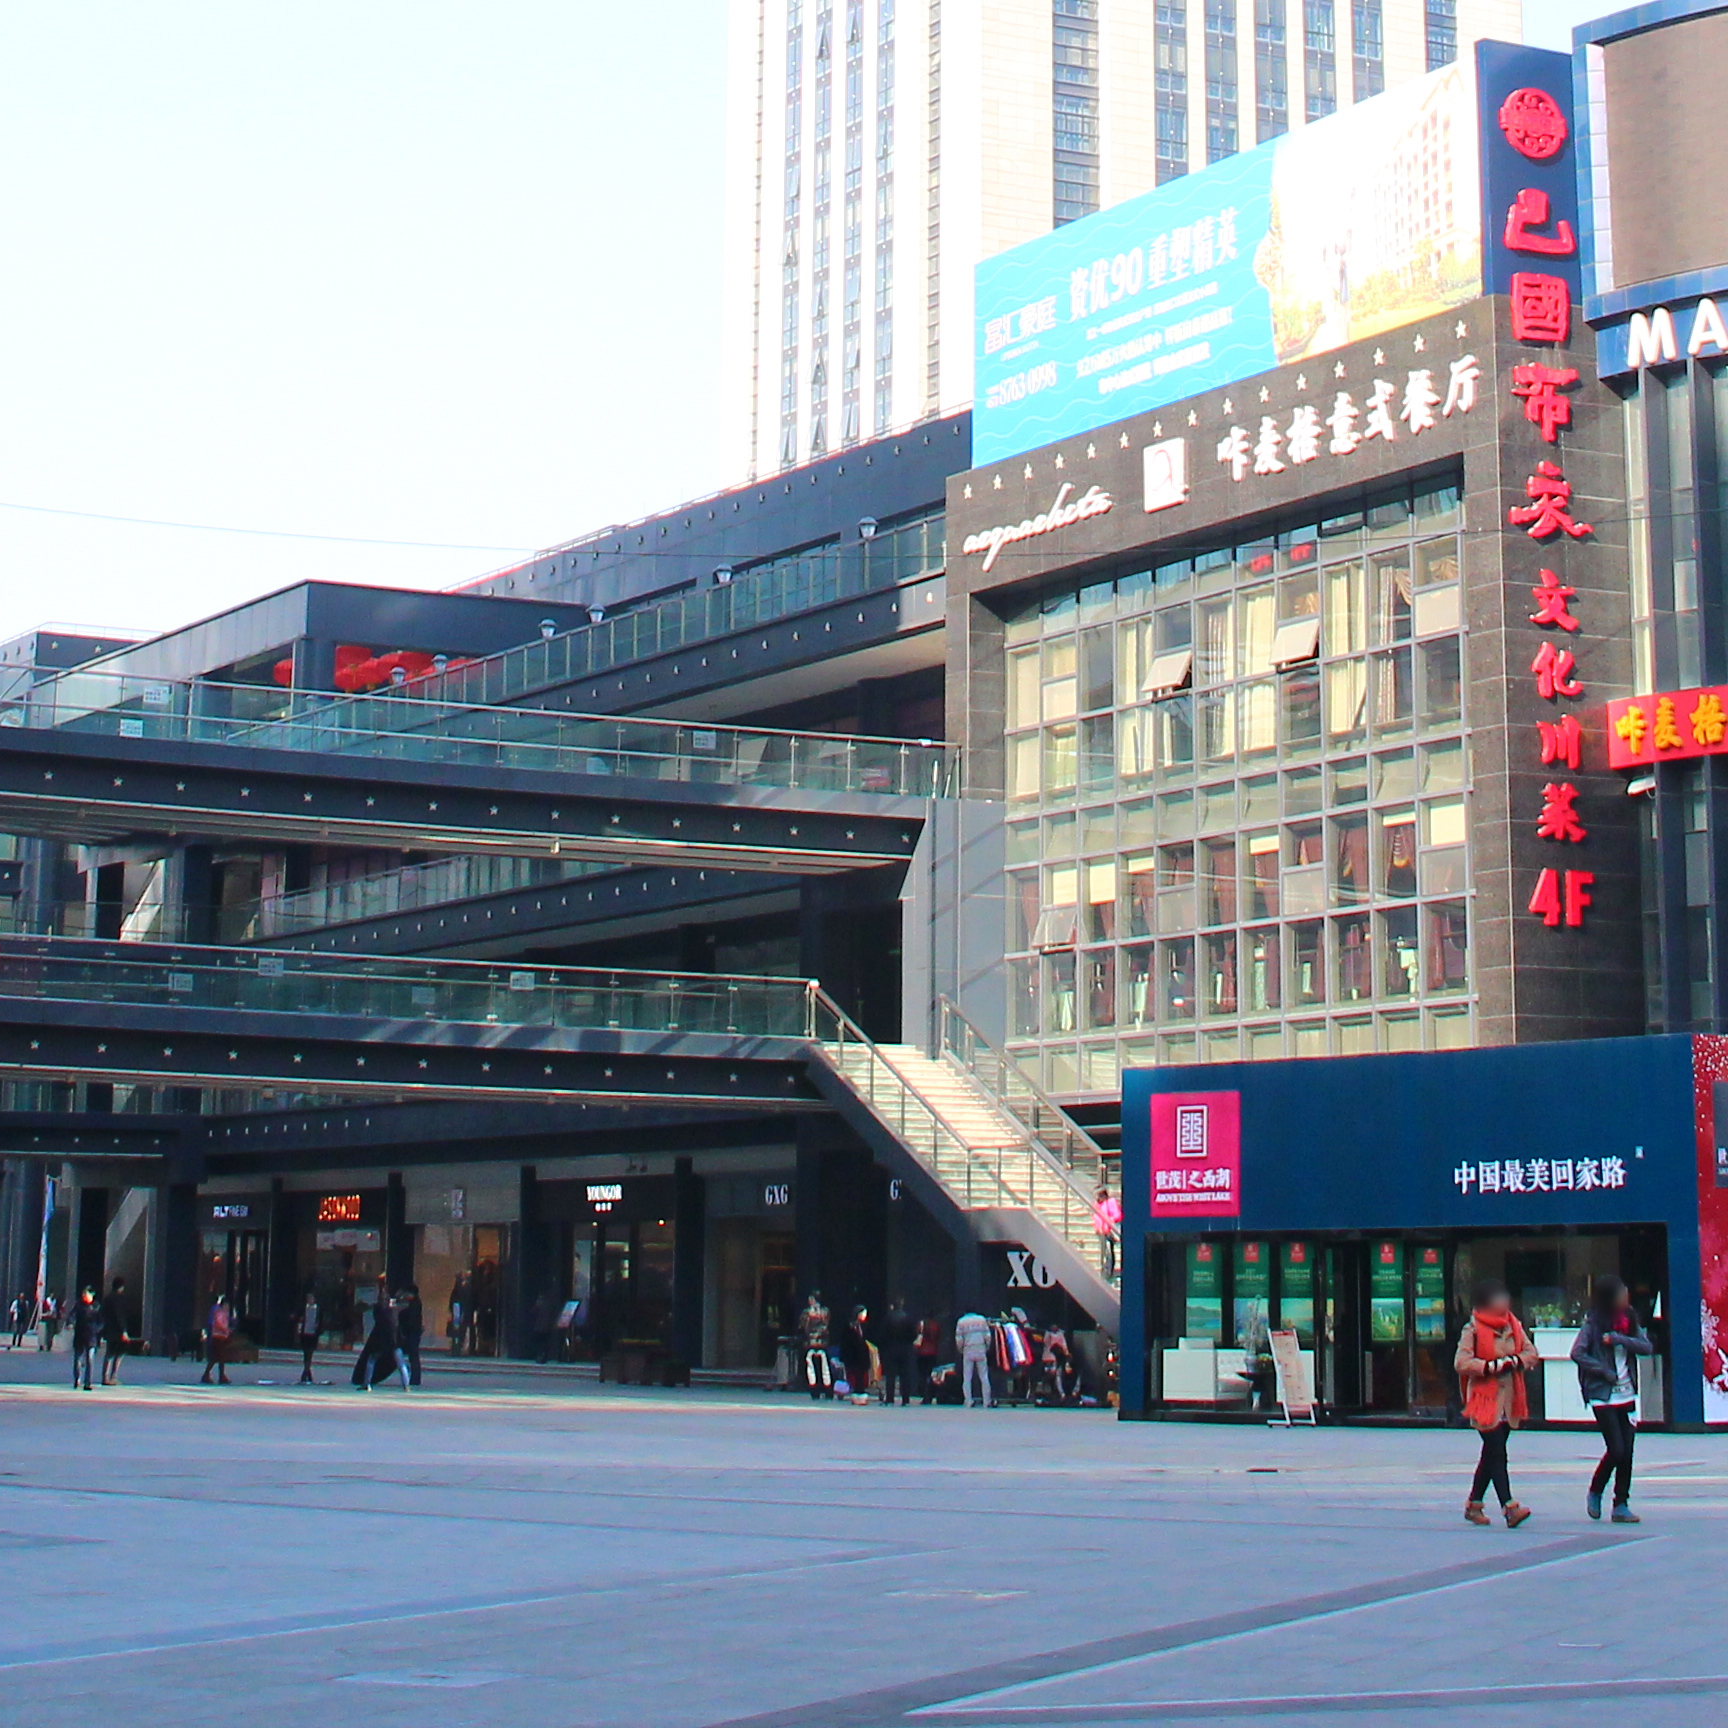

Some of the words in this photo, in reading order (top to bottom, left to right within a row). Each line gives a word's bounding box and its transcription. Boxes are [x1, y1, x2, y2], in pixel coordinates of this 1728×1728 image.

[1529, 867, 1593, 928] 4F
[765, 1184, 789, 1205] GXG
[1454, 1155, 1628, 1195] 中国最美回家路
